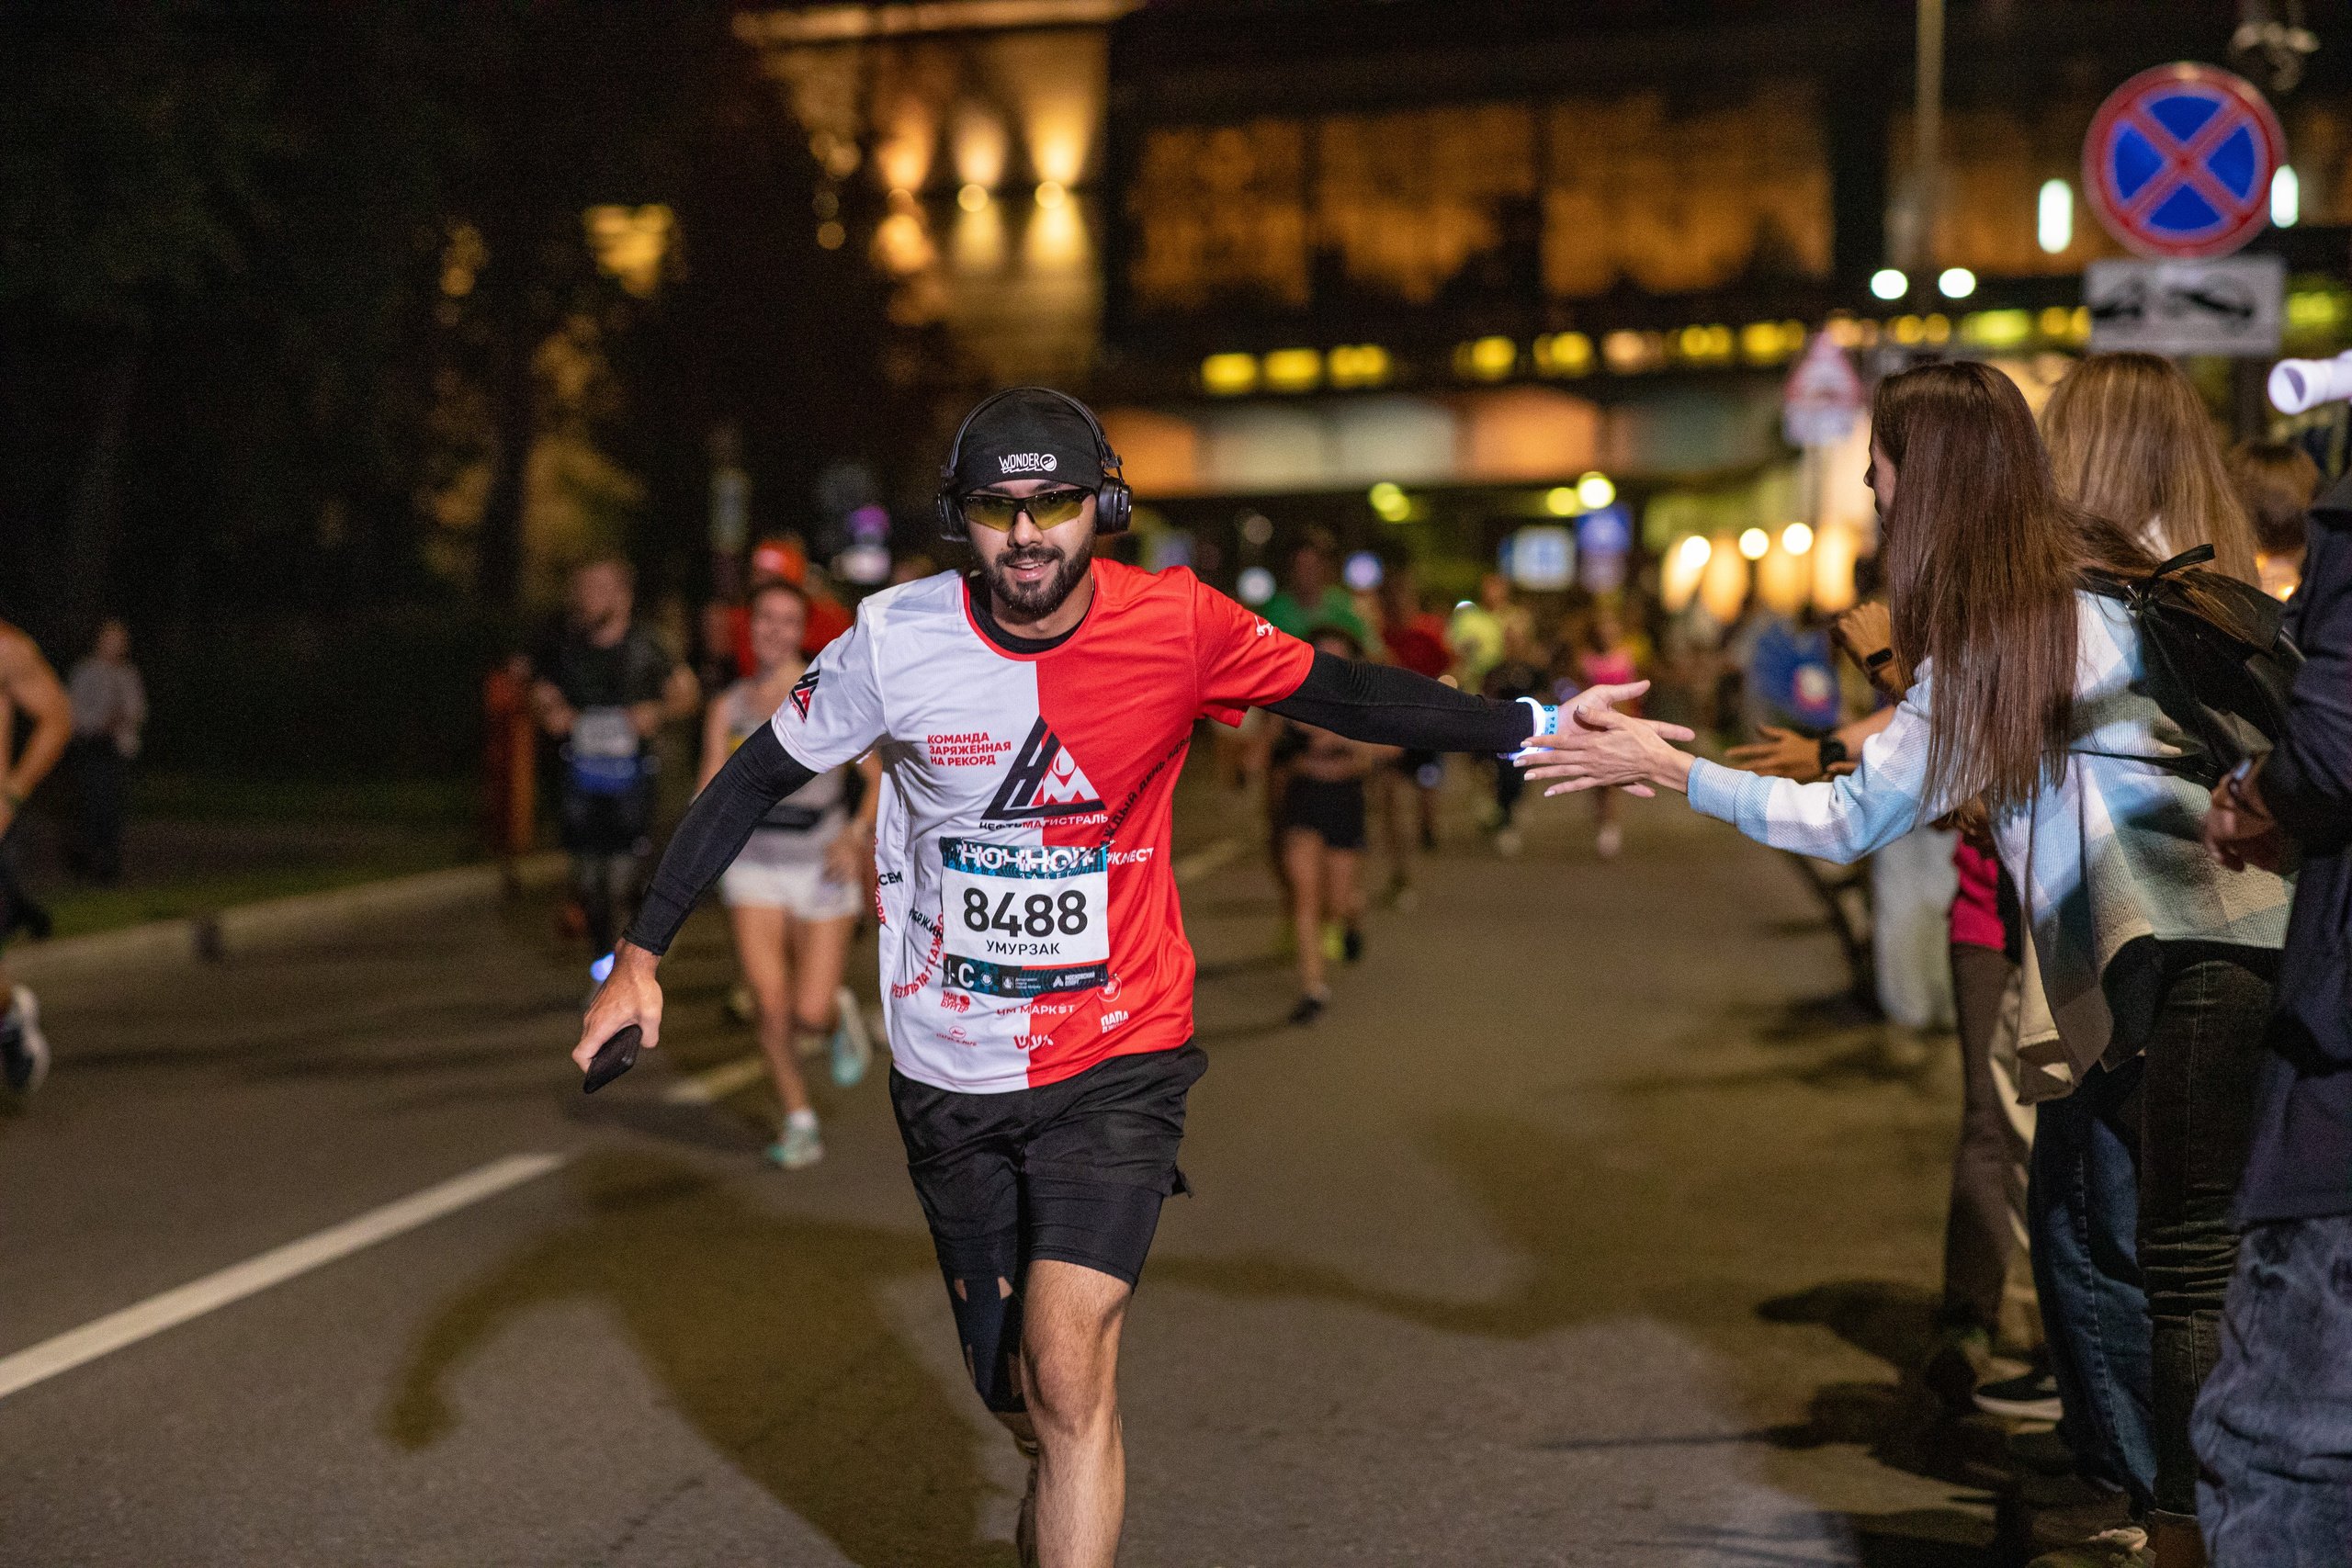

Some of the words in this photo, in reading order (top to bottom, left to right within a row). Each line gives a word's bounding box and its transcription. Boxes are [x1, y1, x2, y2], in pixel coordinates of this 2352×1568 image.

[998, 453, 1040, 468] WONDER
[927, 732, 989, 744] КОМАНДА
[929, 741, 1012, 755] ЗАРЯЖЕННАЯ
[930, 756, 945, 766] НА
[947, 754, 997, 766] РЕКОРД
[1139, 761, 1165, 794] ДЕНЬ
[964, 887, 1088, 937] 8488
[986, 940, 1060, 955] УМУРЗАК
[1101, 1010, 1129, 1026] ПАПА
